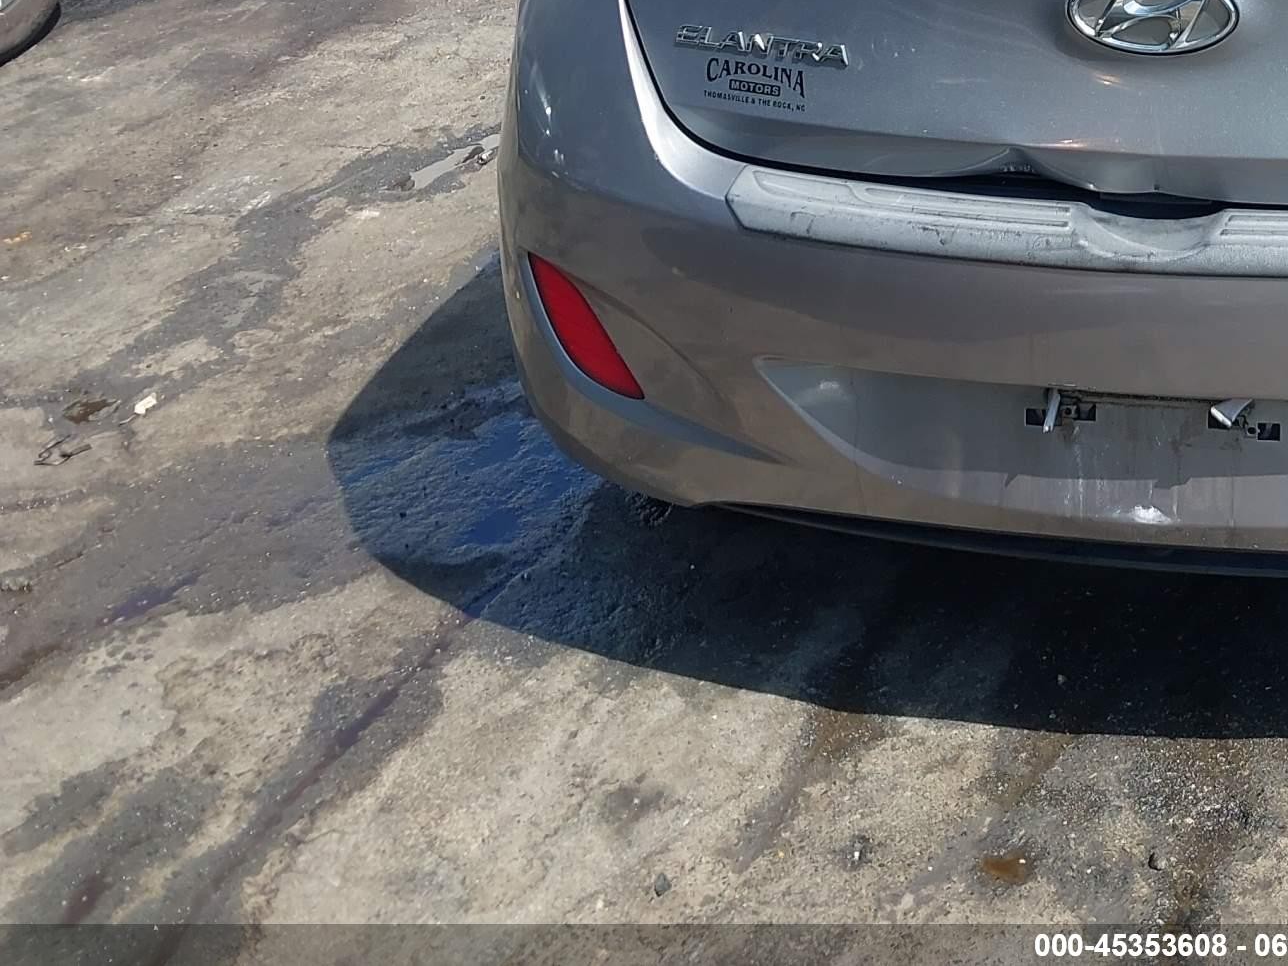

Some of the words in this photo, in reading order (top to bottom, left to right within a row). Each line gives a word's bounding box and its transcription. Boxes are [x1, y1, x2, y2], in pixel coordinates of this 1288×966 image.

[674, 24, 849, 68] ELANTRA
[706, 57, 805, 98] CAROLINA
[730, 81, 780, 96] MOTORS
[703, 89, 749, 104] THOMASVILLE
[758, 98, 771, 107] THE
